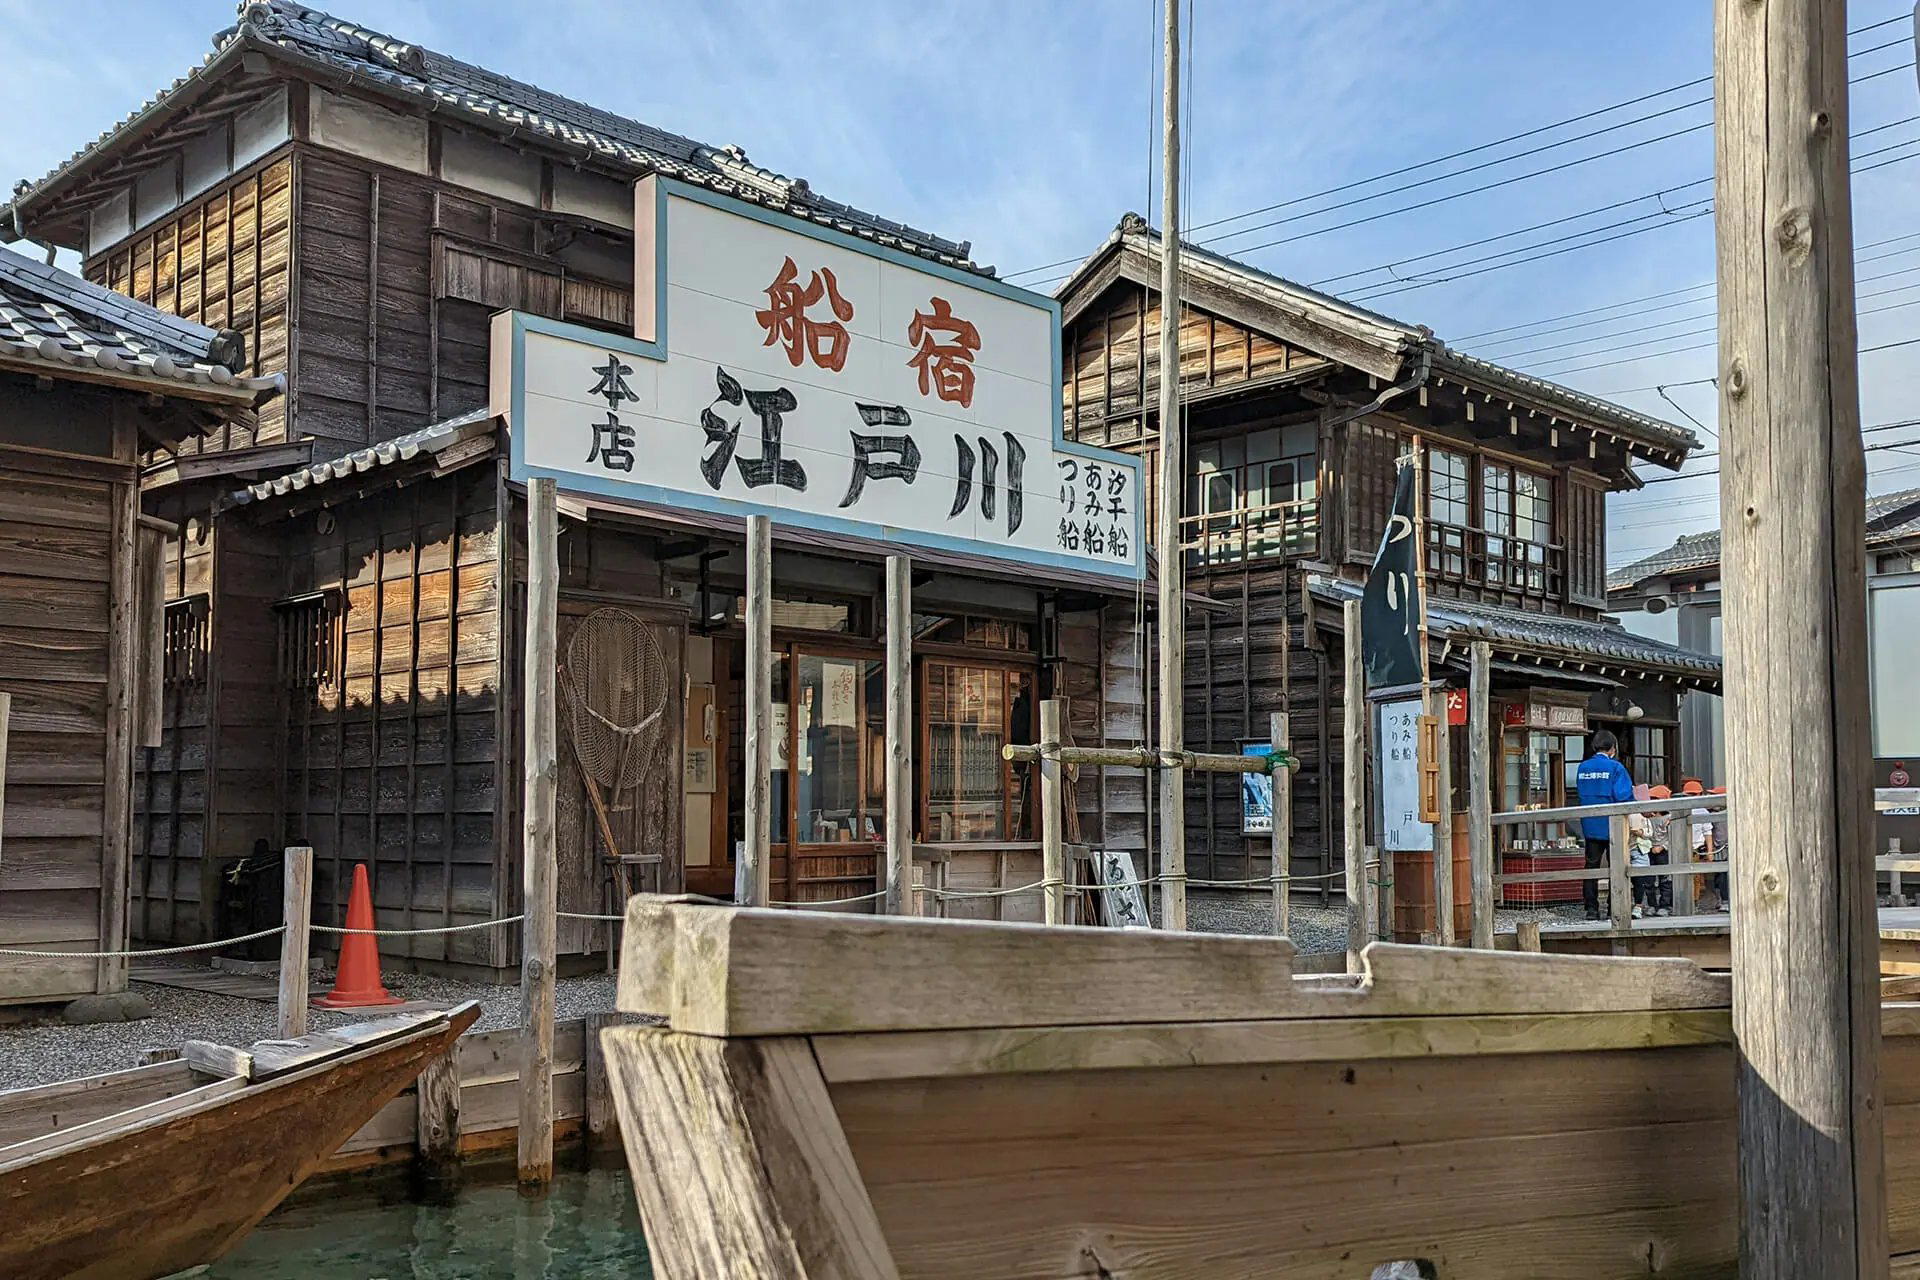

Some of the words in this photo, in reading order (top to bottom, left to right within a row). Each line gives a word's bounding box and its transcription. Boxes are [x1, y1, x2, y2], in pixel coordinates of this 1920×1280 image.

[754, 255, 982, 408] 船宿
[585, 352, 640, 472] 本店
[699, 364, 1027, 538] 江戸川
[1057, 459, 1080, 551] つり船
[1082, 461, 1105, 555] あみ船
[1107, 468, 1129, 559] 汐干船
[1386, 514, 1413, 636] つり
[1389, 714, 1400, 761] つり船
[1402, 713, 1412, 761] あみ船
